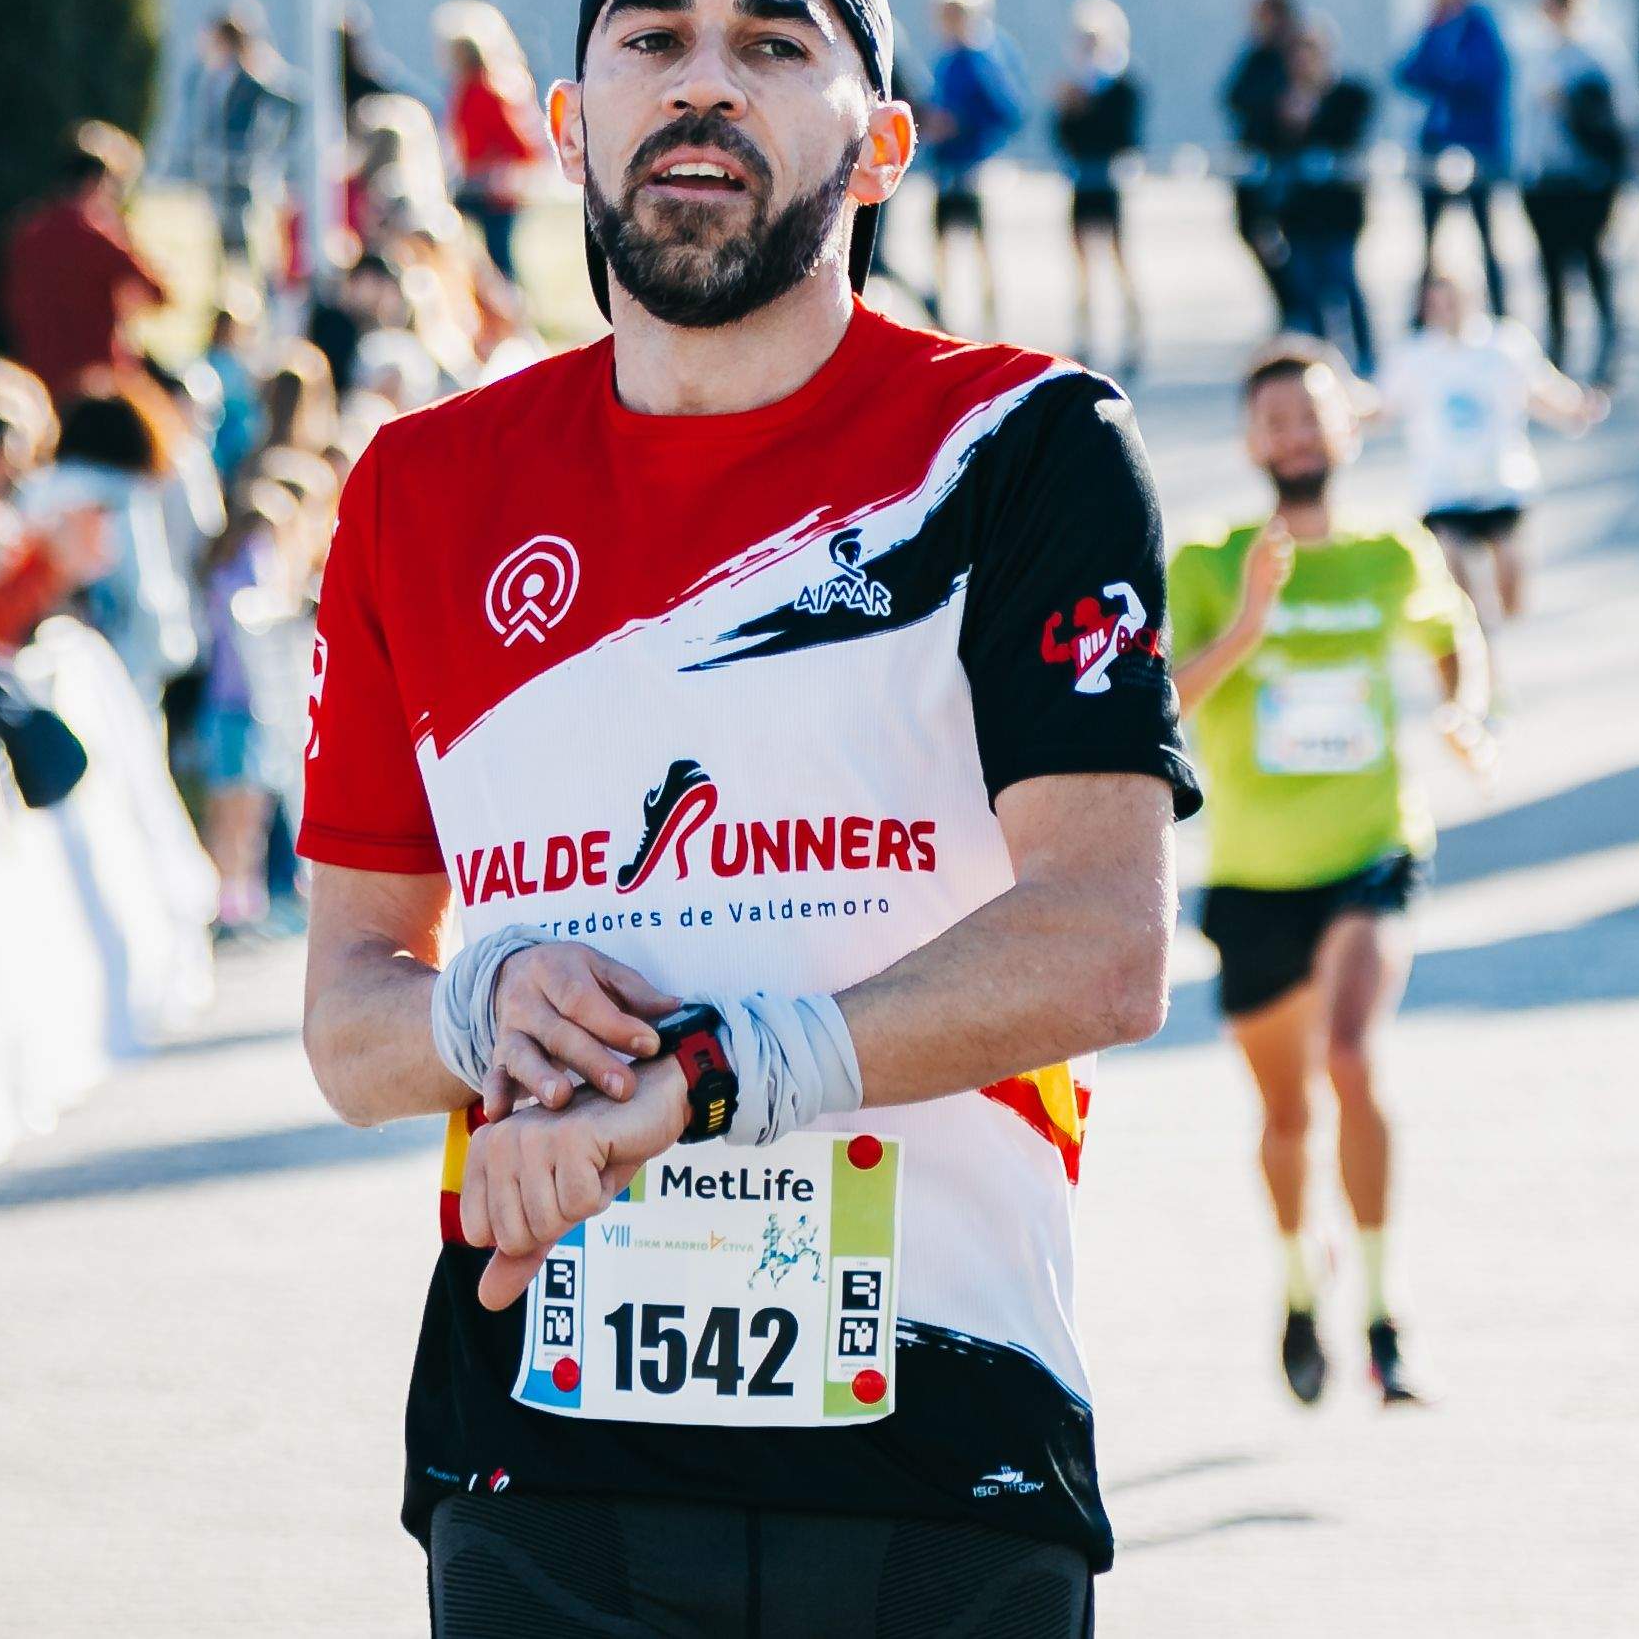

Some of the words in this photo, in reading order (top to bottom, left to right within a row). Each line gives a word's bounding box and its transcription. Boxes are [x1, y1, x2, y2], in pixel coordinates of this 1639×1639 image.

[794, 581, 892, 616] AIMAR
[1078, 628, 1108, 669] NIL
[679, 906, 714, 928] de
[728, 896, 892, 924] Valdemoro
[660, 1164, 815, 1203] MetLife
[601, 1223, 631, 1249] VIII
[604, 1302, 799, 1398] 1542
